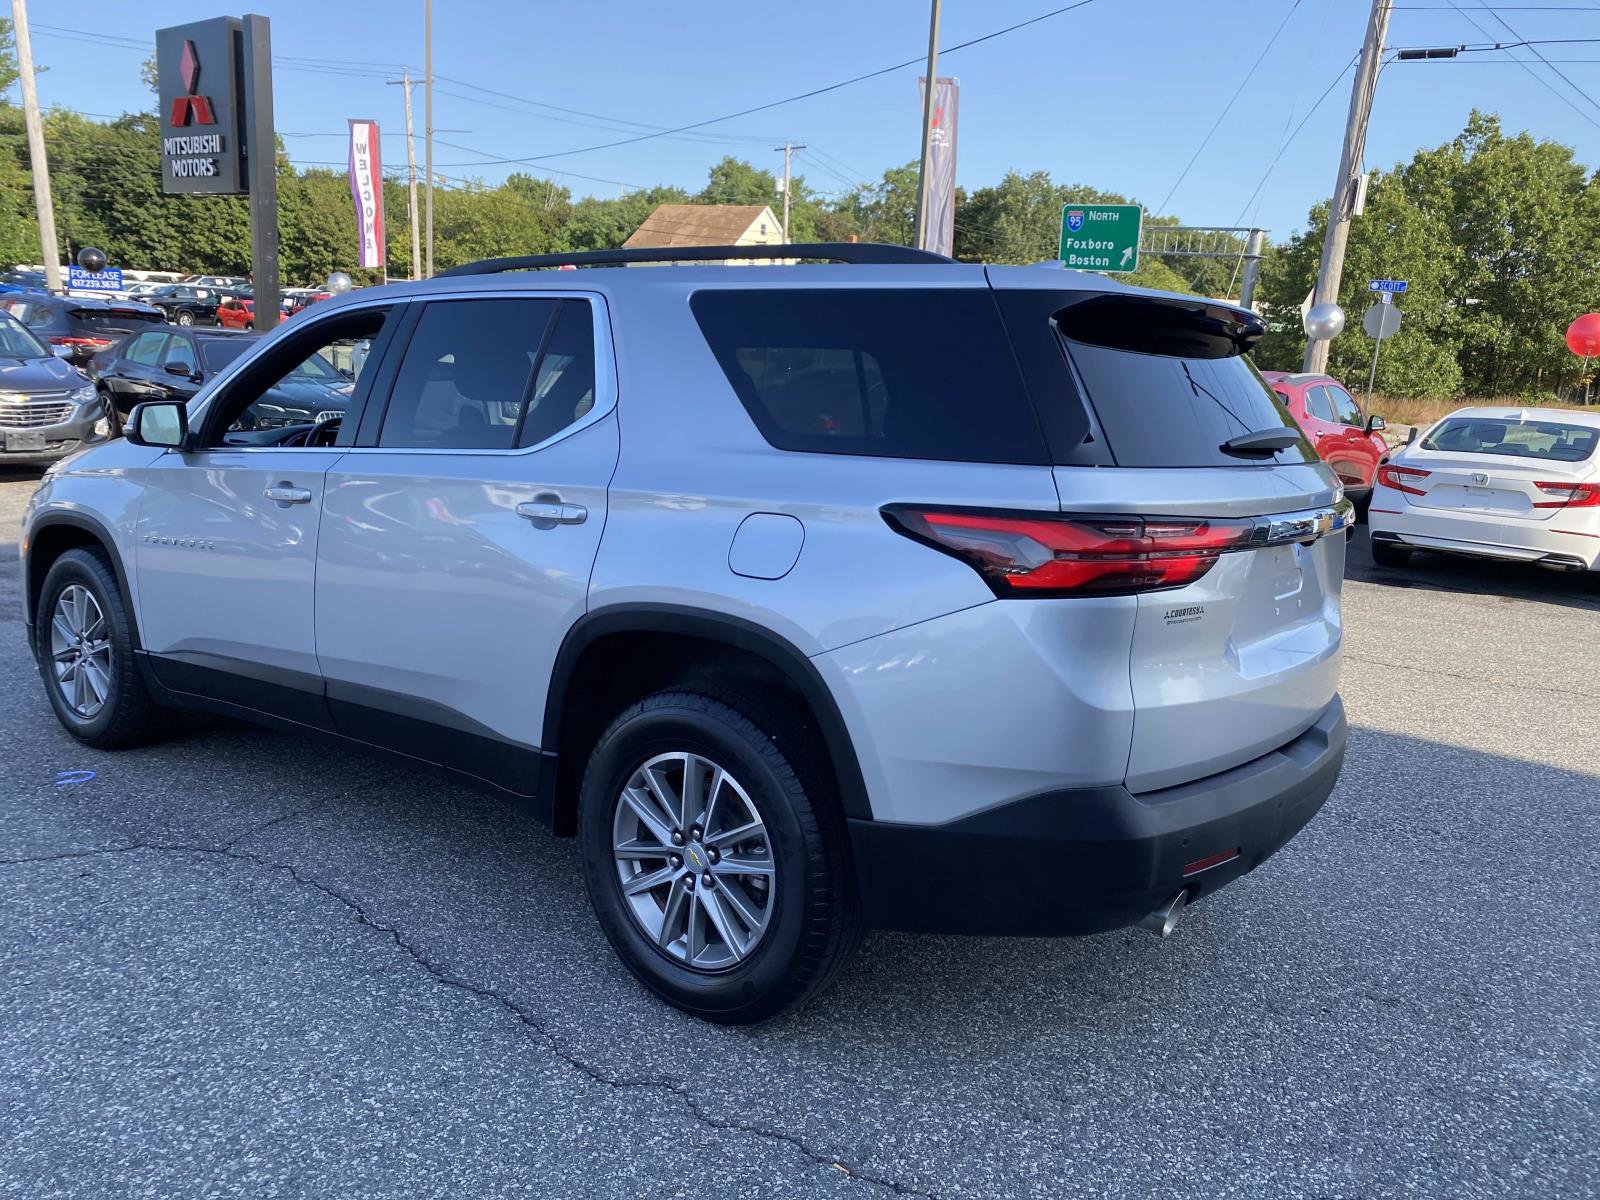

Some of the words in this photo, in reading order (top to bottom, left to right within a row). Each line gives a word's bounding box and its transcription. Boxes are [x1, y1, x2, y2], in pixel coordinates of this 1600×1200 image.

[164, 134, 220, 155] MITSUBISHI
[172, 157, 213, 177] MOTORS
[1069, 216, 1081, 227] 95
[1088, 210, 1120, 221] NORTH
[1066, 237, 1114, 250] Foxboro
[1068, 253, 1110, 266] Boston
[70, 269, 91, 279] FOR
[1379, 281, 1402, 291] SCOTT
